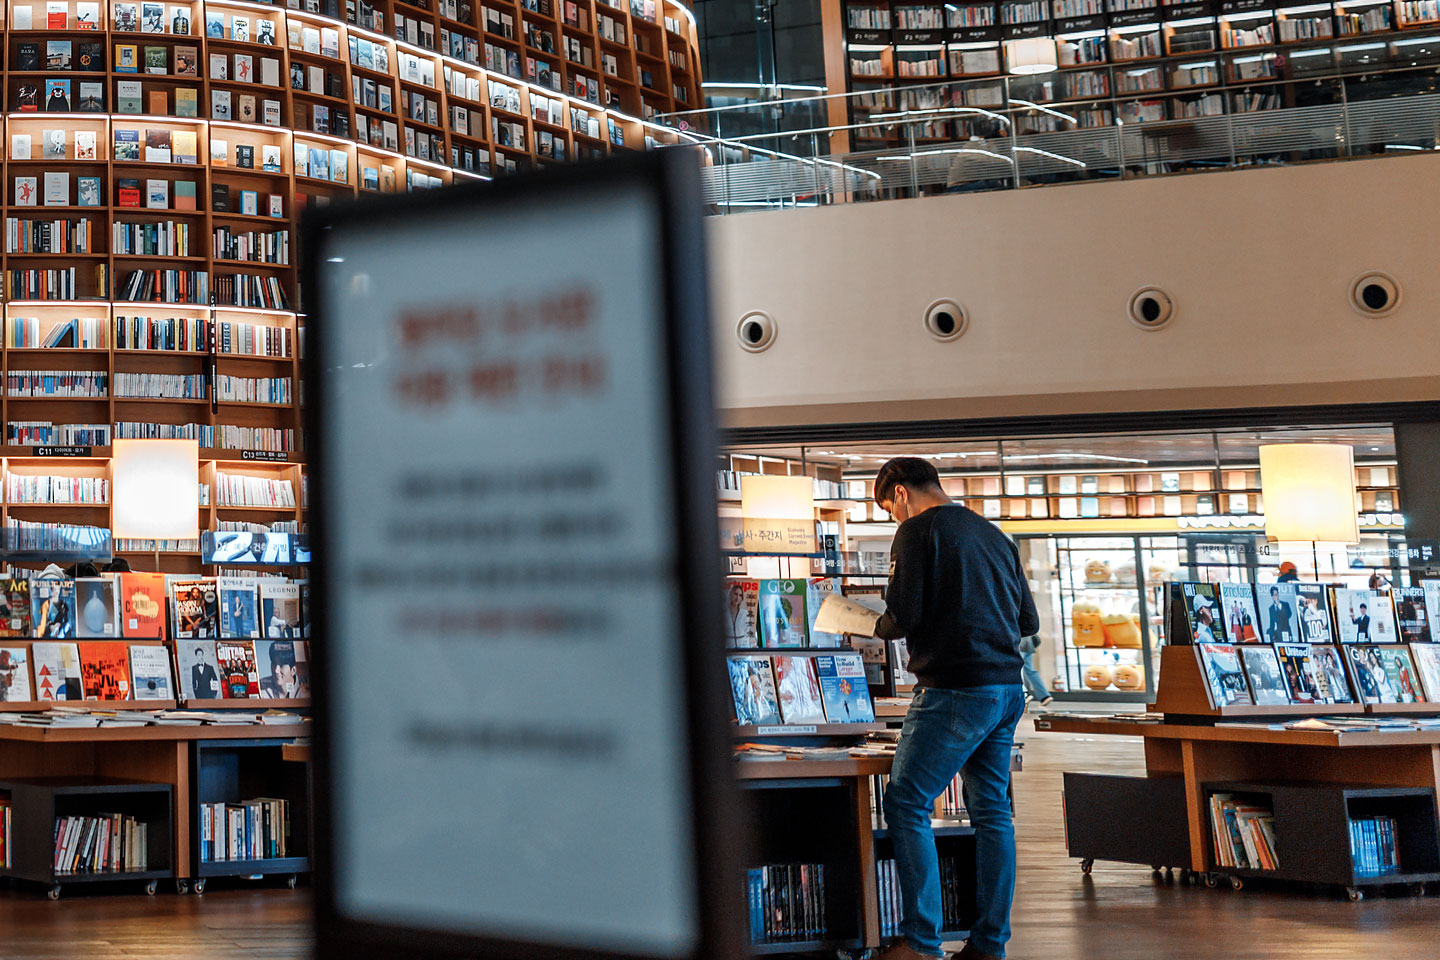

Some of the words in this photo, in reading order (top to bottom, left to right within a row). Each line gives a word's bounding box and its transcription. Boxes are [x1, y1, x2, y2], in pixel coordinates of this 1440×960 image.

[243, 451, 254, 459] C13
[10, 580, 27, 592] Art
[59, 580, 74, 588] ART
[768, 580, 795, 593] GEO
[1307, 620, 1322, 637] 100
[218, 646, 246, 660] GUITAR
[1285, 646, 1308, 656] United
